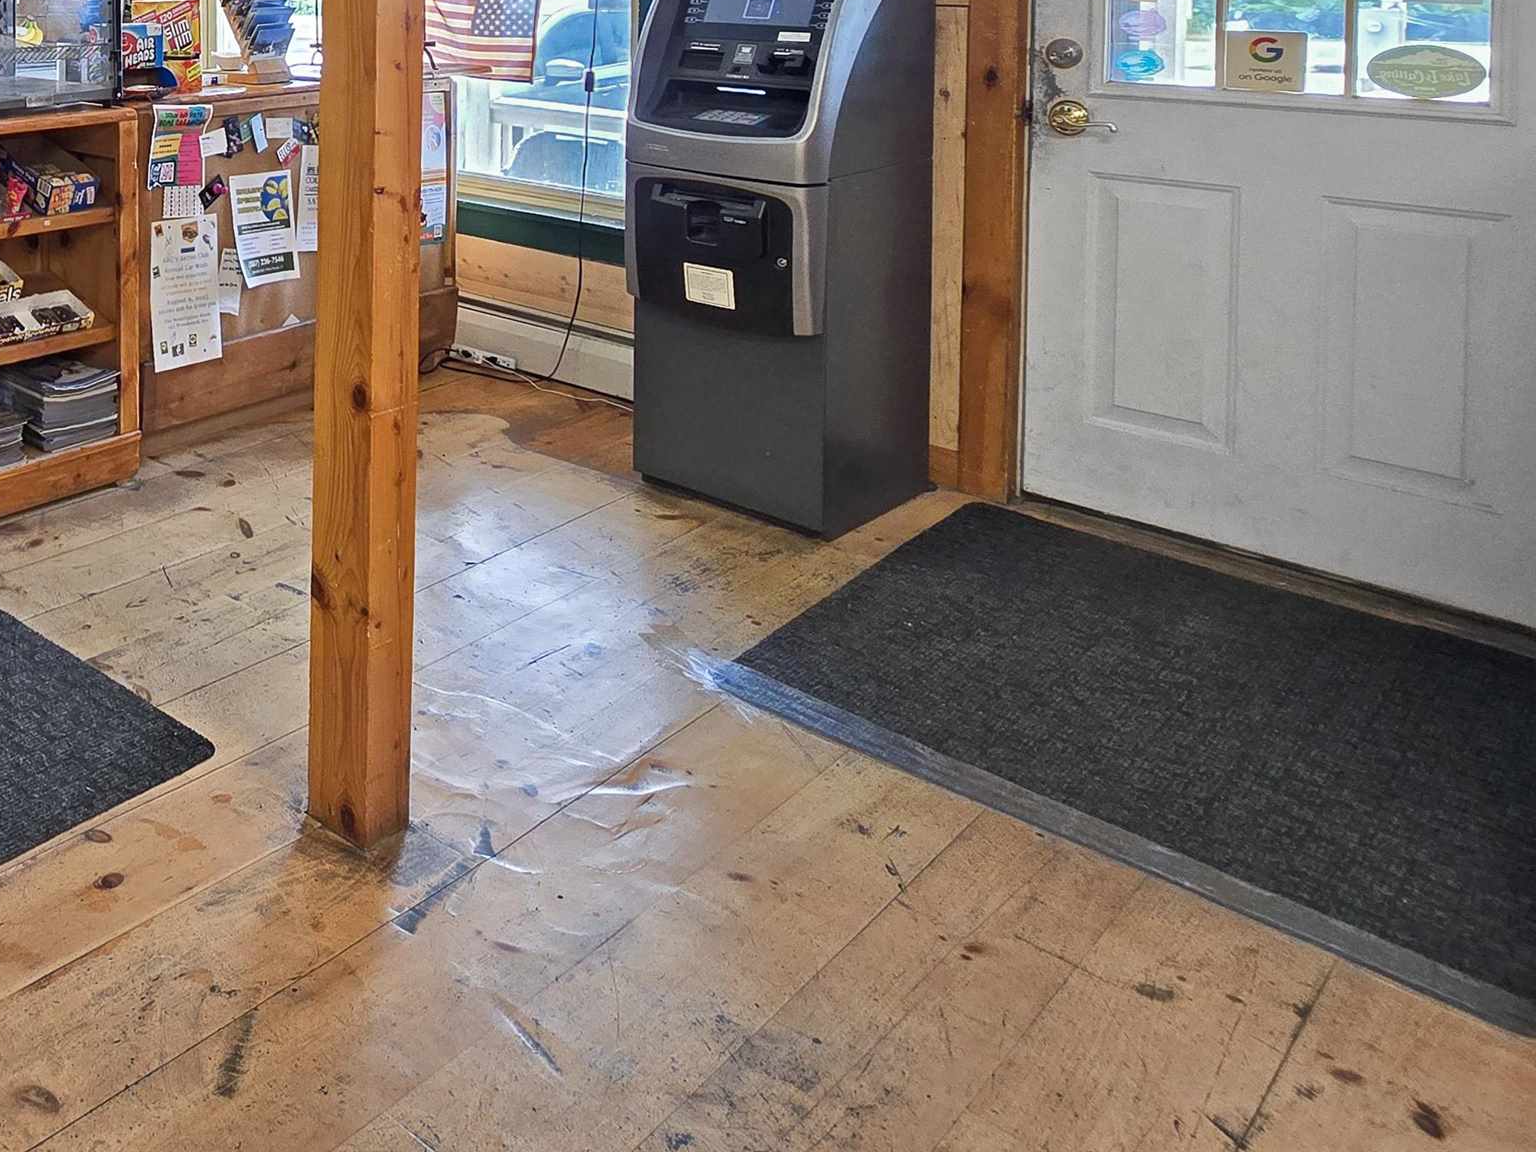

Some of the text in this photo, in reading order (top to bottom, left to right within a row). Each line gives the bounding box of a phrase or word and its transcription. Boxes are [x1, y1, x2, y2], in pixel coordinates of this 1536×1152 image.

[136, 37, 155, 52] AIR
[125, 49, 155, 67] HEADS
[1254, 73, 1293, 84] Google
